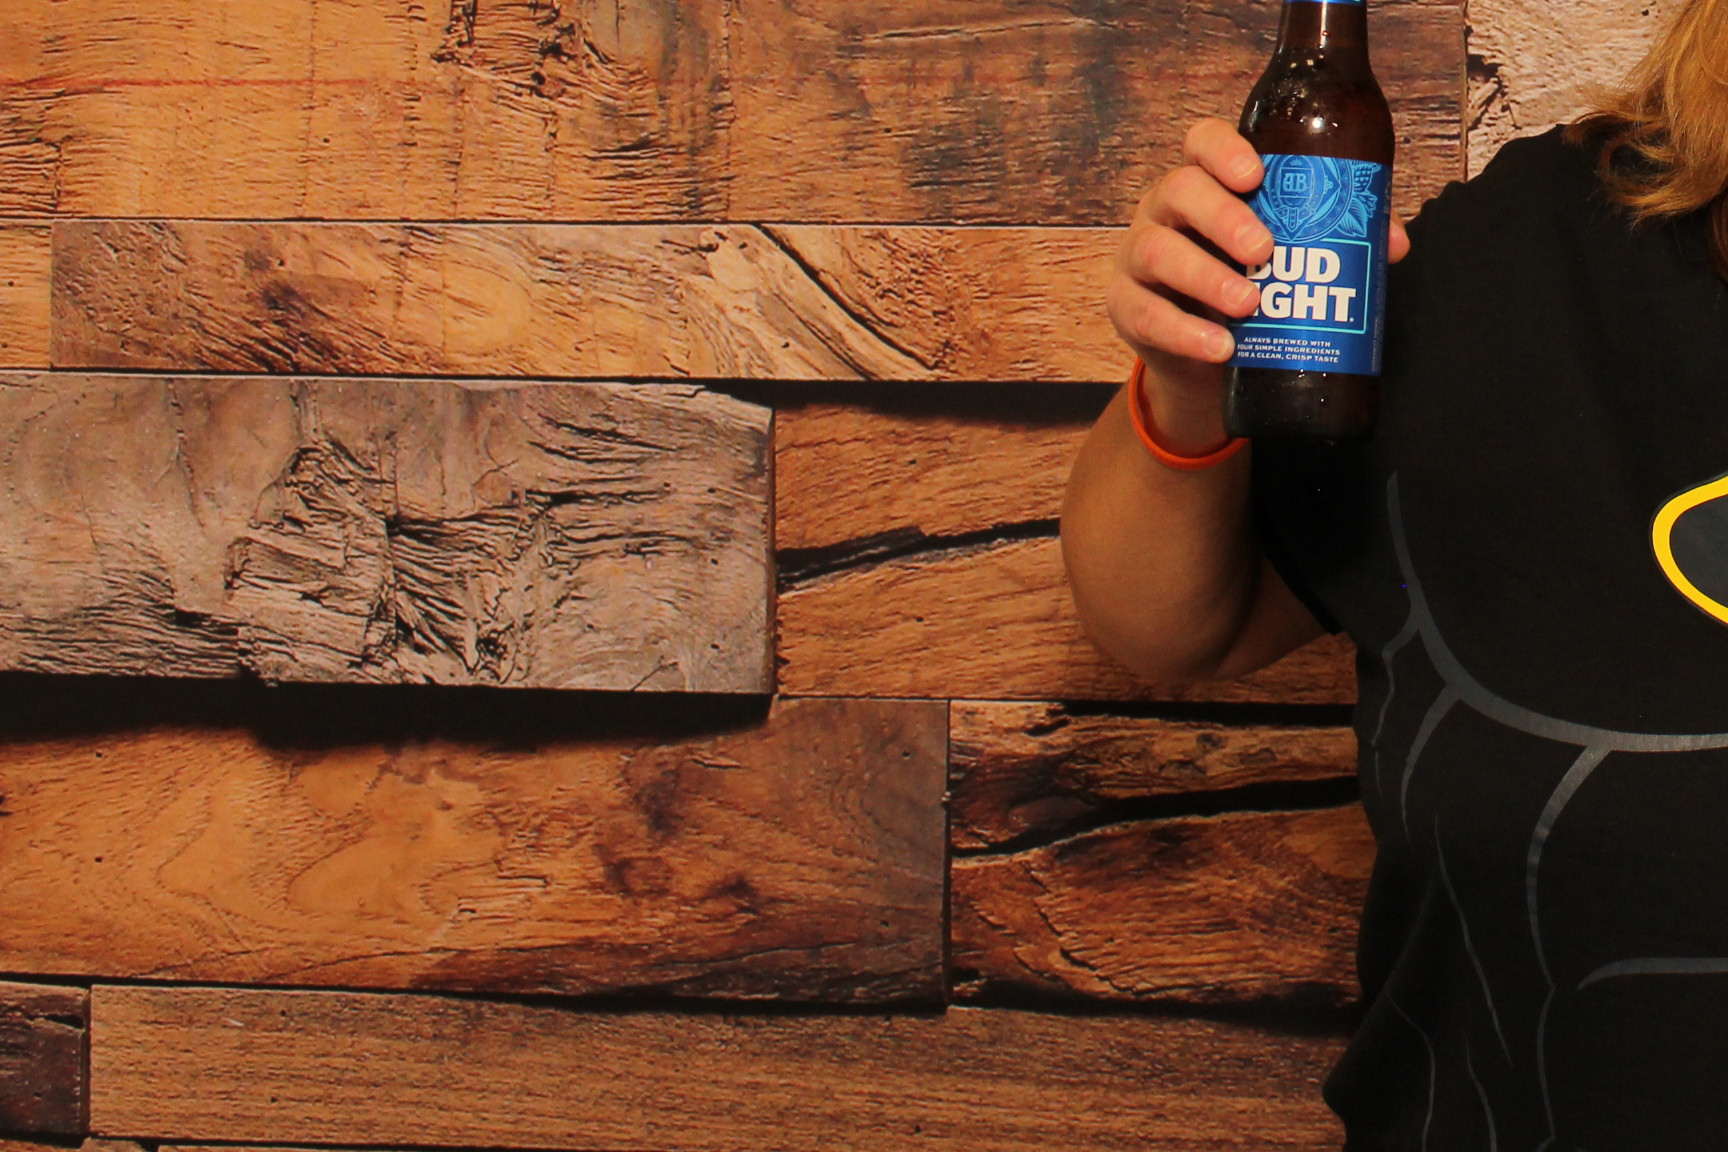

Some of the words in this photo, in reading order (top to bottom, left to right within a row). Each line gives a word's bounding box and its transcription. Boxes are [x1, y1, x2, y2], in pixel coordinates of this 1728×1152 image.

[1244, 336, 1271, 344] ALWAYS
[1273, 337, 1308, 346] BREWED
[1254, 344, 1283, 352] SIMPLE
[1284, 346, 1341, 356] INGREDIENTS
[1256, 352, 1284, 360] CLEAN,
[1285, 353, 1313, 361] CRISP
[1314, 355, 1339, 363] TASTE
